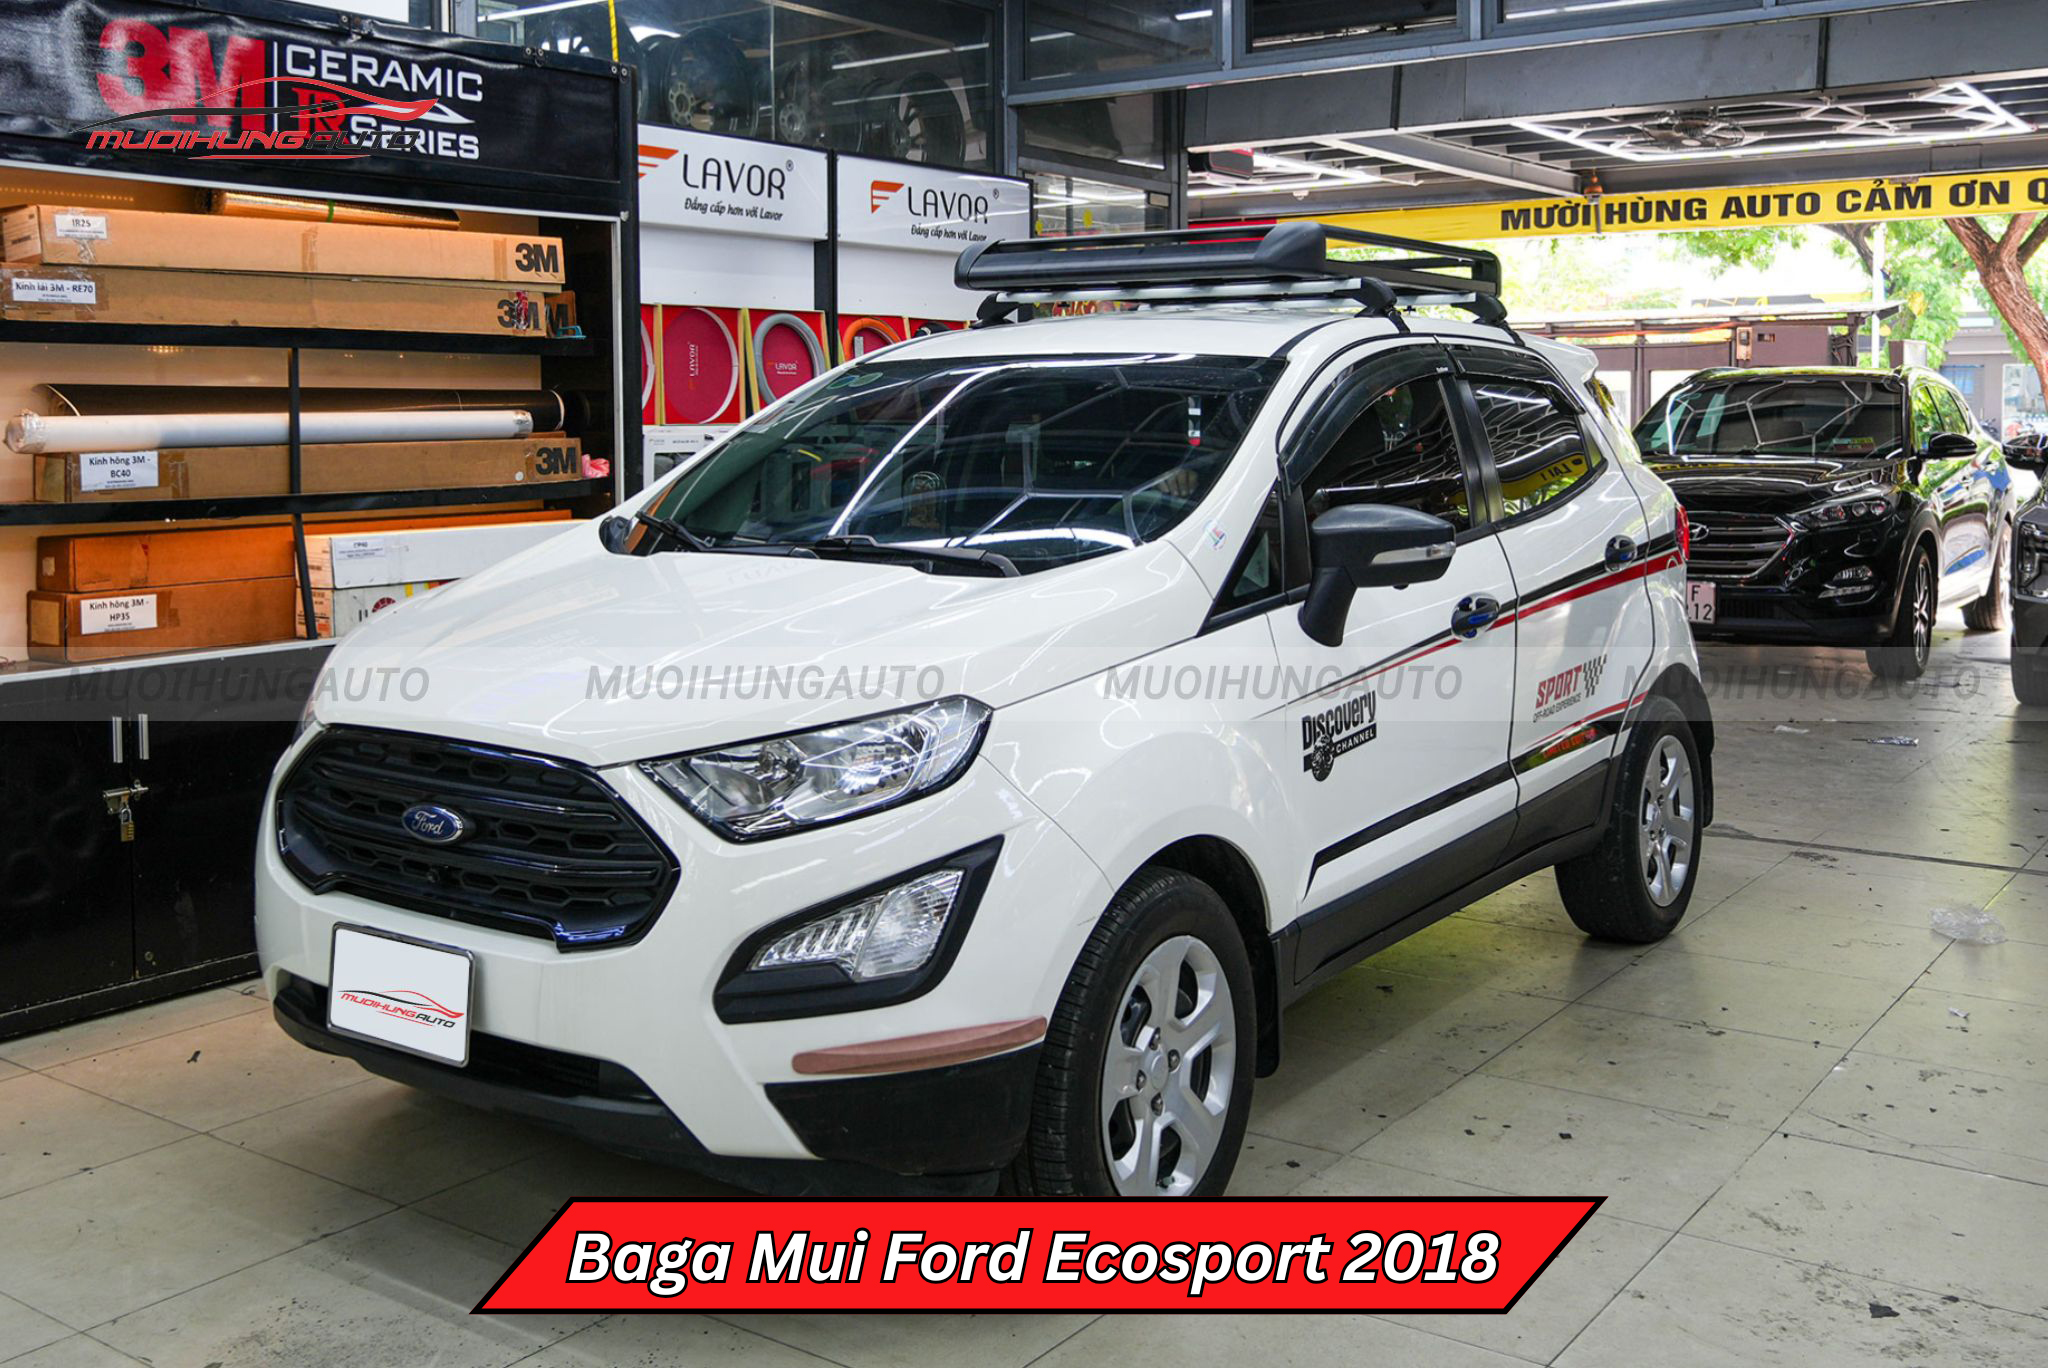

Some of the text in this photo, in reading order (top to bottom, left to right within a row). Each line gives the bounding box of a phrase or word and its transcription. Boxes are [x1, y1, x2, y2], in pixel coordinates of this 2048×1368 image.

[97, 20, 265, 133] 3M
[285, 44, 483, 102] CERAMIC
[350, 115, 480, 160] SERIES
[682, 153, 786, 200] LAVOR
[760, 208, 783, 221] Lavor
[908, 186, 988, 225] LAVOR
[1501, 200, 1591, 231] MƯỜI
[1604, 197, 1707, 225] HÙNG
[1720, 192, 1820, 220] AUTO
[1836, 179, 1932, 213] CẢM
[1949, 180, 2010, 207] ƠN
[969, 231, 987, 242] Lavor
[515, 243, 559, 273] 3M
[50, 283, 65, 292] 3M
[72, 284, 94, 293] RE70
[132, 455, 145, 464] 3M
[535, 447, 577, 475] 3M
[110, 469, 131, 478] BC40
[131, 598, 144, 607] 3M
[109, 611, 130, 621] HP35
[1535, 664, 1583, 709] SPORT
[1335, 728, 1375, 753] CHANNEL
[412, 811, 445, 835] Ford
